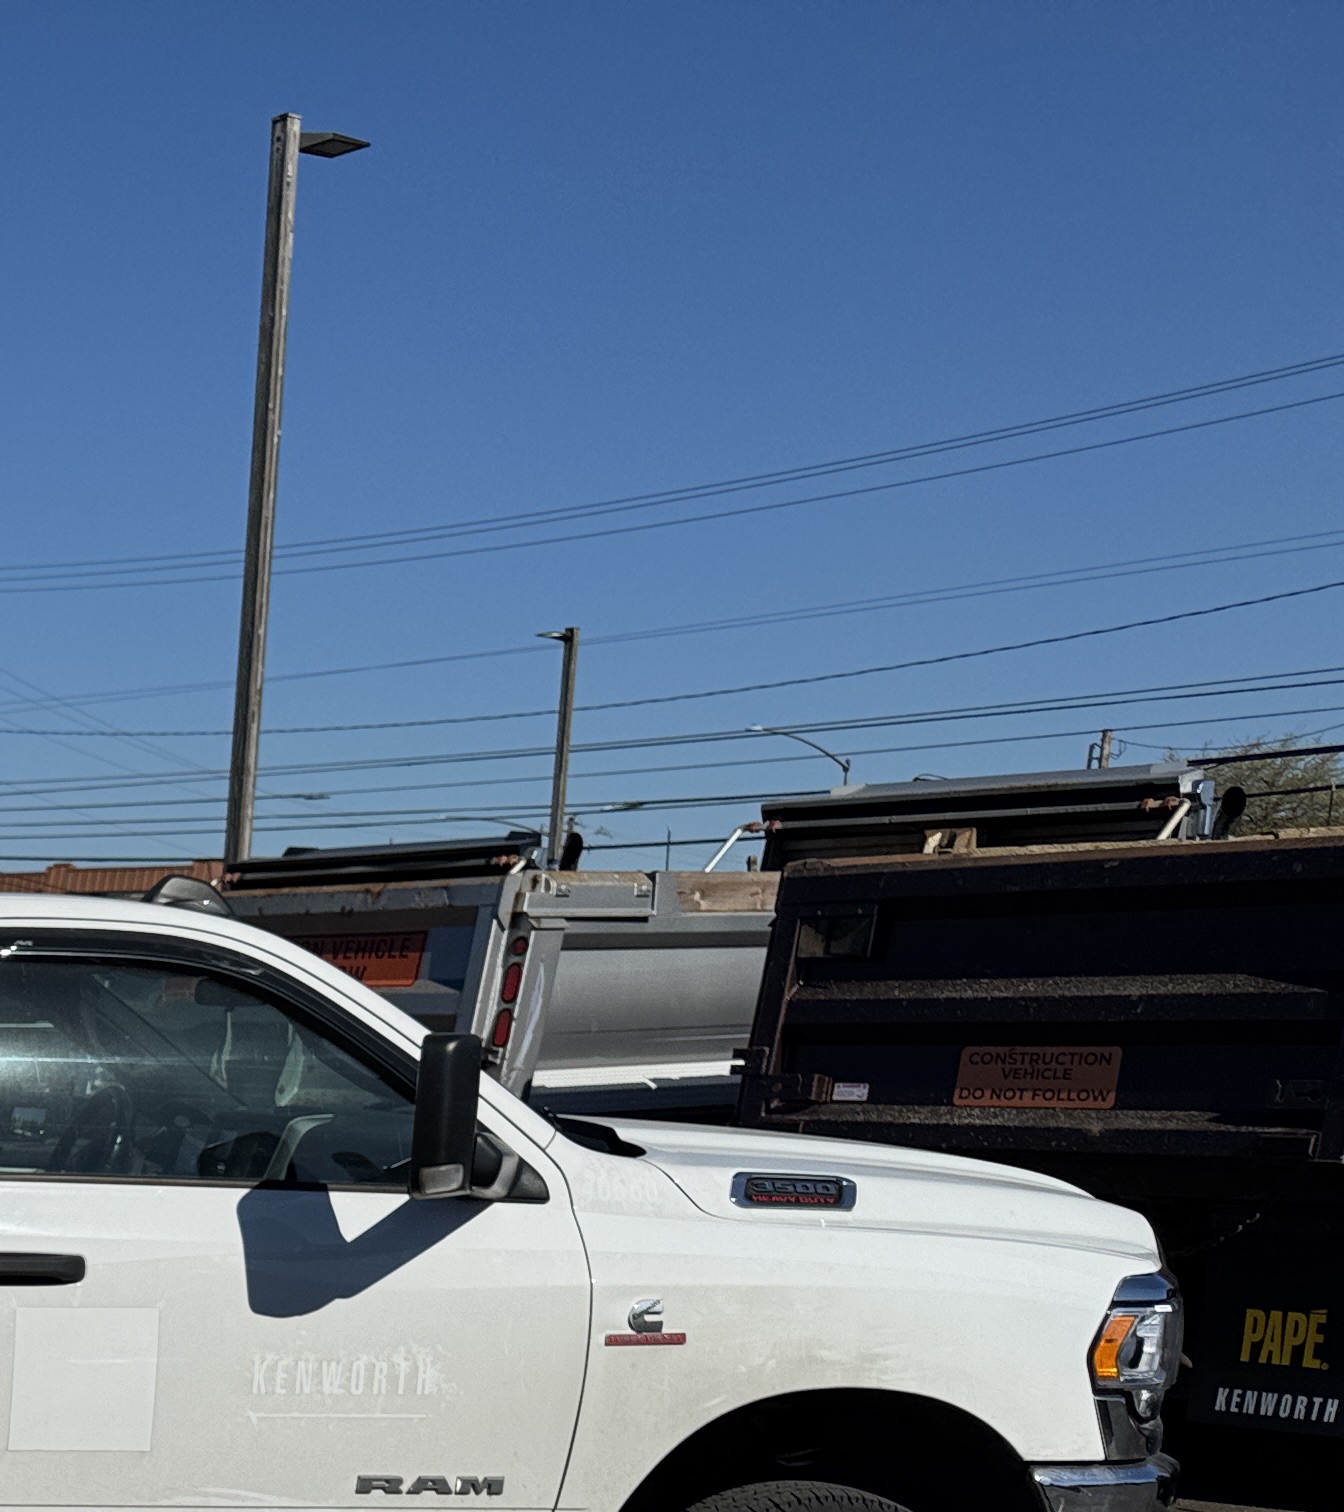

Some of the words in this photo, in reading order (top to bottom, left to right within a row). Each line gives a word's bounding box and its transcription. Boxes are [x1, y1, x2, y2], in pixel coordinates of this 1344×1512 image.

[332, 938, 411, 960] VEHICLE
[968, 1051, 1112, 1067] CONSTRUCTION
[1002, 1067, 1073, 1081] VEHICLE
[958, 1087, 985, 1100] DO
[989, 1087, 1028, 1101] NOT
[1031, 1088, 1111, 1103] FOLLOW
[751, 1181, 837, 1196] 3500
[1215, 1387, 1340, 1423] KENWORTH
[355, 1475, 505, 1496] RAM
